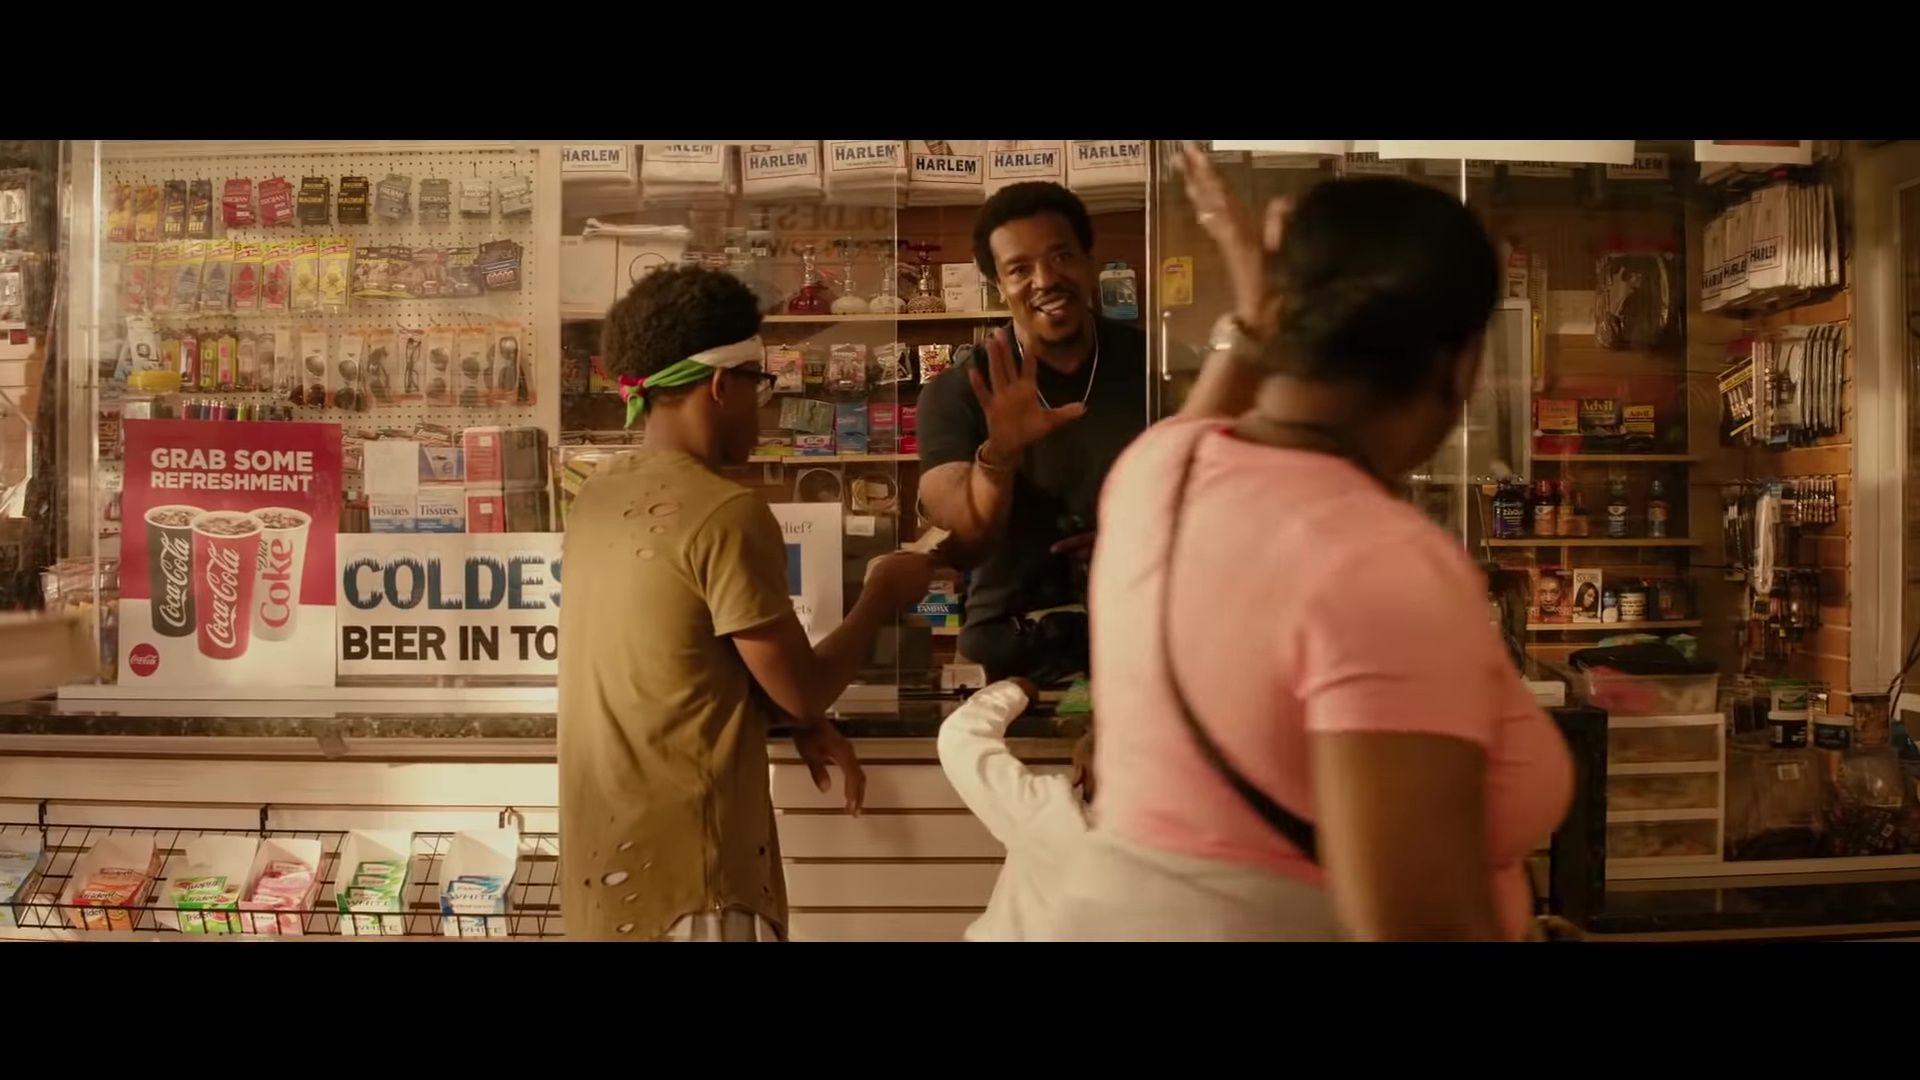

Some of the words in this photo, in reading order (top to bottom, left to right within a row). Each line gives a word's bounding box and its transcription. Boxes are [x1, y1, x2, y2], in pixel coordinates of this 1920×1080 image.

[561, 149, 620, 162] HARLEM
[835, 144, 896, 160] HARLEM
[1079, 144, 1140, 160] HARLEM
[750, 153, 808, 168] HARLEM
[916, 158, 976, 173] HARLEM
[994, 153, 1054, 167] HARLEM
[1583, 399, 1613, 412] Advil
[151, 448, 226, 470] GRAB
[234, 450, 313, 472] SOME
[151, 472, 313, 492] REFRESHMENT
[372, 505, 410, 516] Tissues
[420, 504, 459, 516] Tissues
[259, 538, 293, 628] Coke
[342, 625, 447, 661] BEER
[459, 625, 499, 661] IN
[510, 625, 559, 661] TO
[461, 925, 500, 933] WHIE
